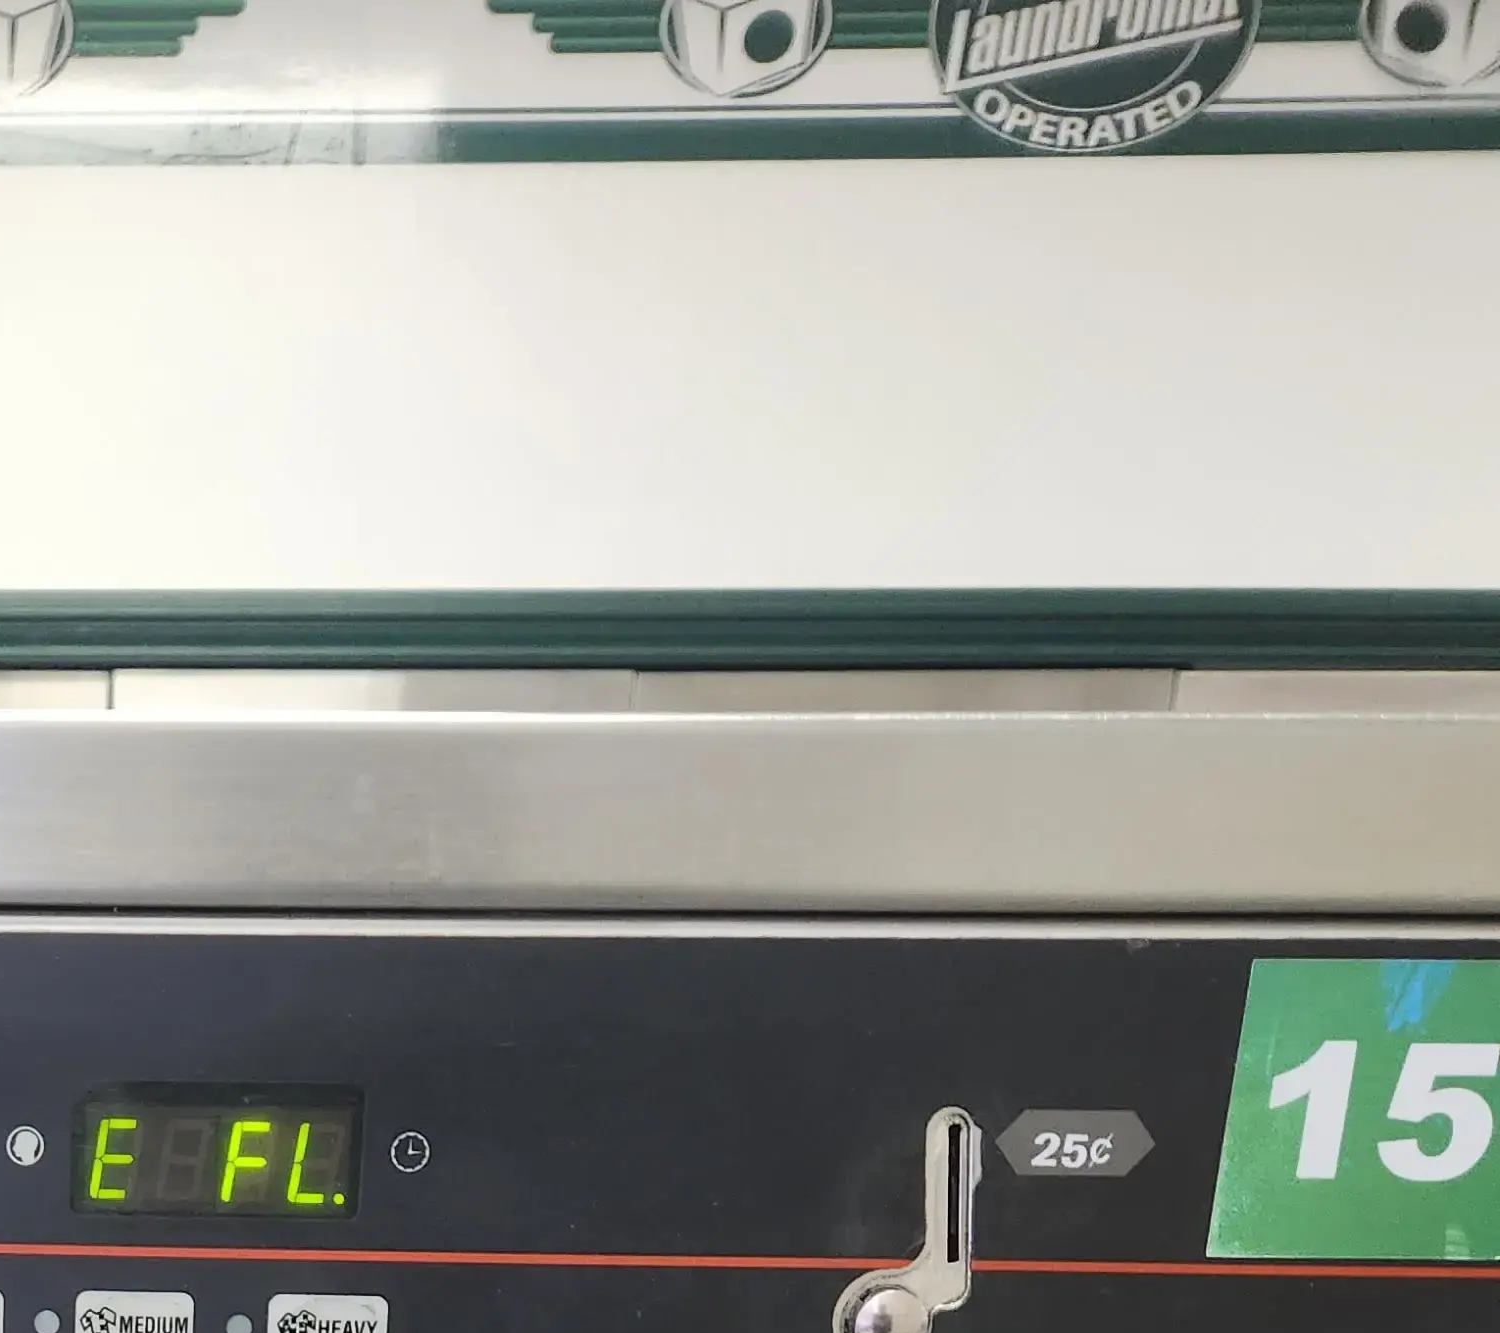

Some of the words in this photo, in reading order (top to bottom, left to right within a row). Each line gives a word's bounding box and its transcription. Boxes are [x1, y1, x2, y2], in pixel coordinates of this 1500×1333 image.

[973, 80, 1203, 148] OPERATED
[1269, 1039, 1500, 1183] 15
[88, 1117, 138, 1200] E
[1030, 1132, 1114, 1170] 25¢
